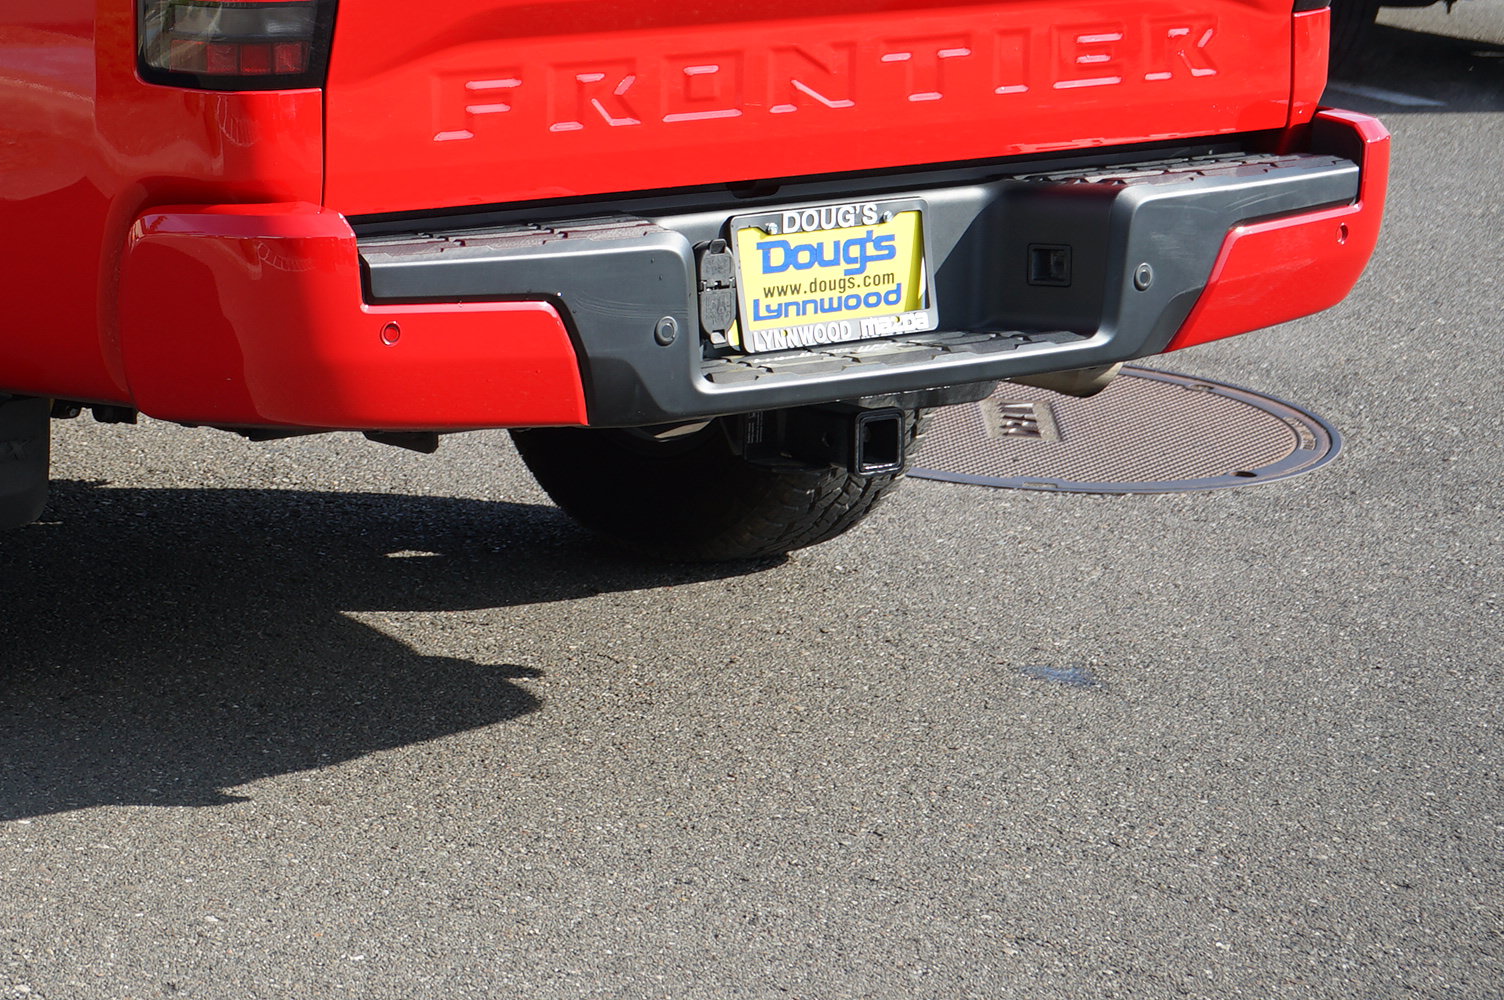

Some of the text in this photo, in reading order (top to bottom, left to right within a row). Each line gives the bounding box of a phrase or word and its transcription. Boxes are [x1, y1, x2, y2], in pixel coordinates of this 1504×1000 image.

[433, 12, 1218, 142] FRONTIER
[782, 203, 879, 234] DOUG'S
[756, 230, 897, 276] Doug's
[753, 283, 902, 322] Lynnwood
[763, 272, 895, 298] www.dougs.com
[753, 311, 930, 352] LYNNWOOD mazda
